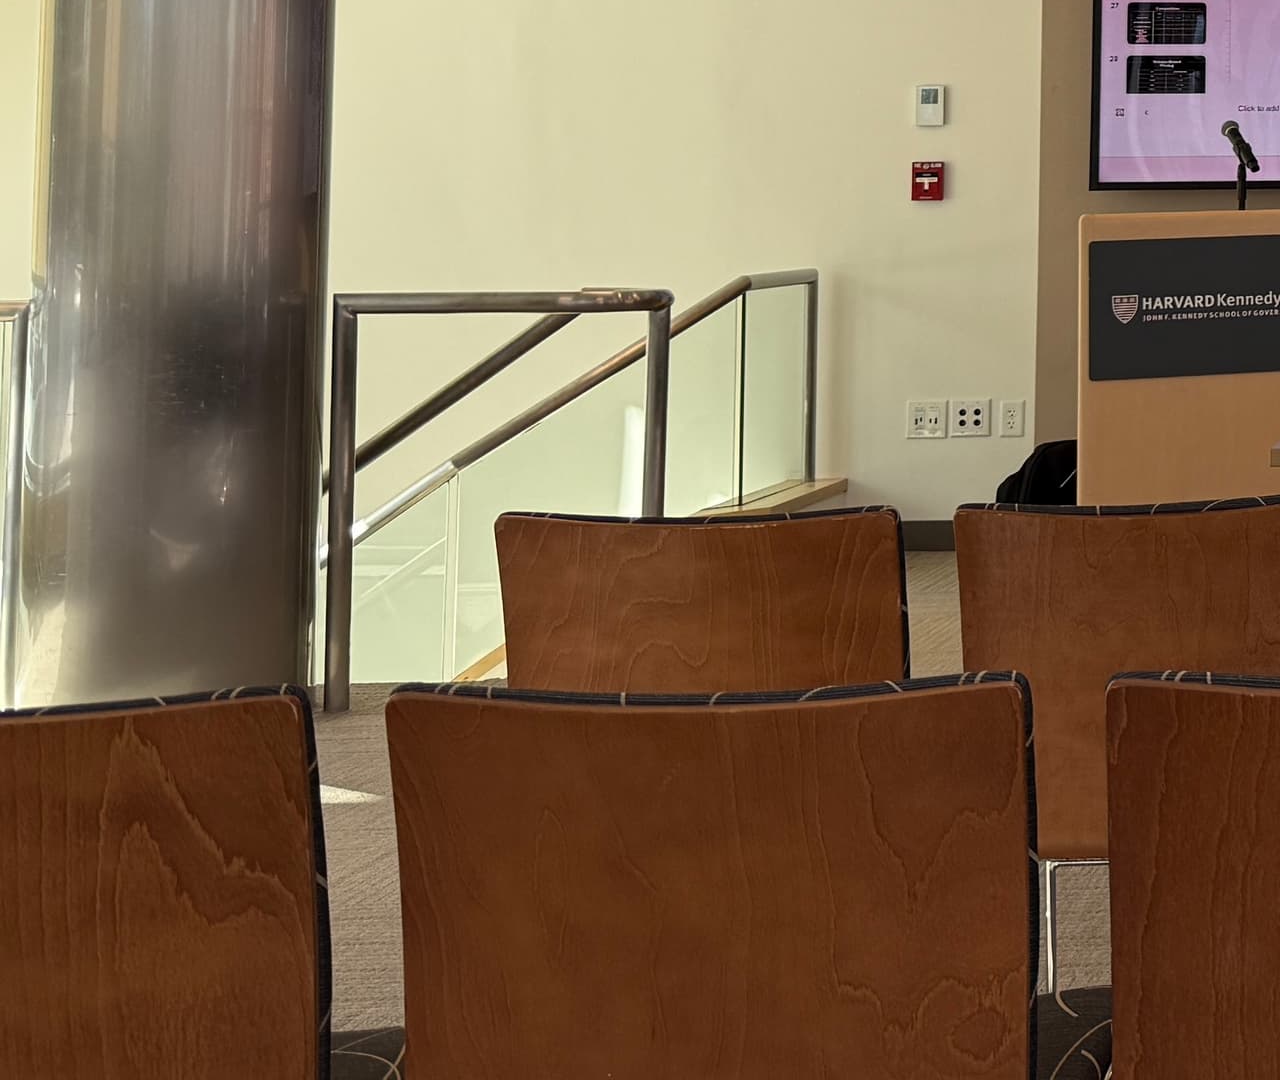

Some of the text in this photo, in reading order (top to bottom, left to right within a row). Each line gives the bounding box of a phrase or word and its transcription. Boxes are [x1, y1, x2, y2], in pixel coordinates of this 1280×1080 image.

[1142, 294, 1215, 311] HARVARD
[1143, 314, 1164, 323] JOHN
[1164, 313, 1171, 321] F.
[1171, 311, 1209, 320] KENNEDY
[1209, 309, 1241, 319] SCHOOL
[1241, 310, 1252, 318] OF
